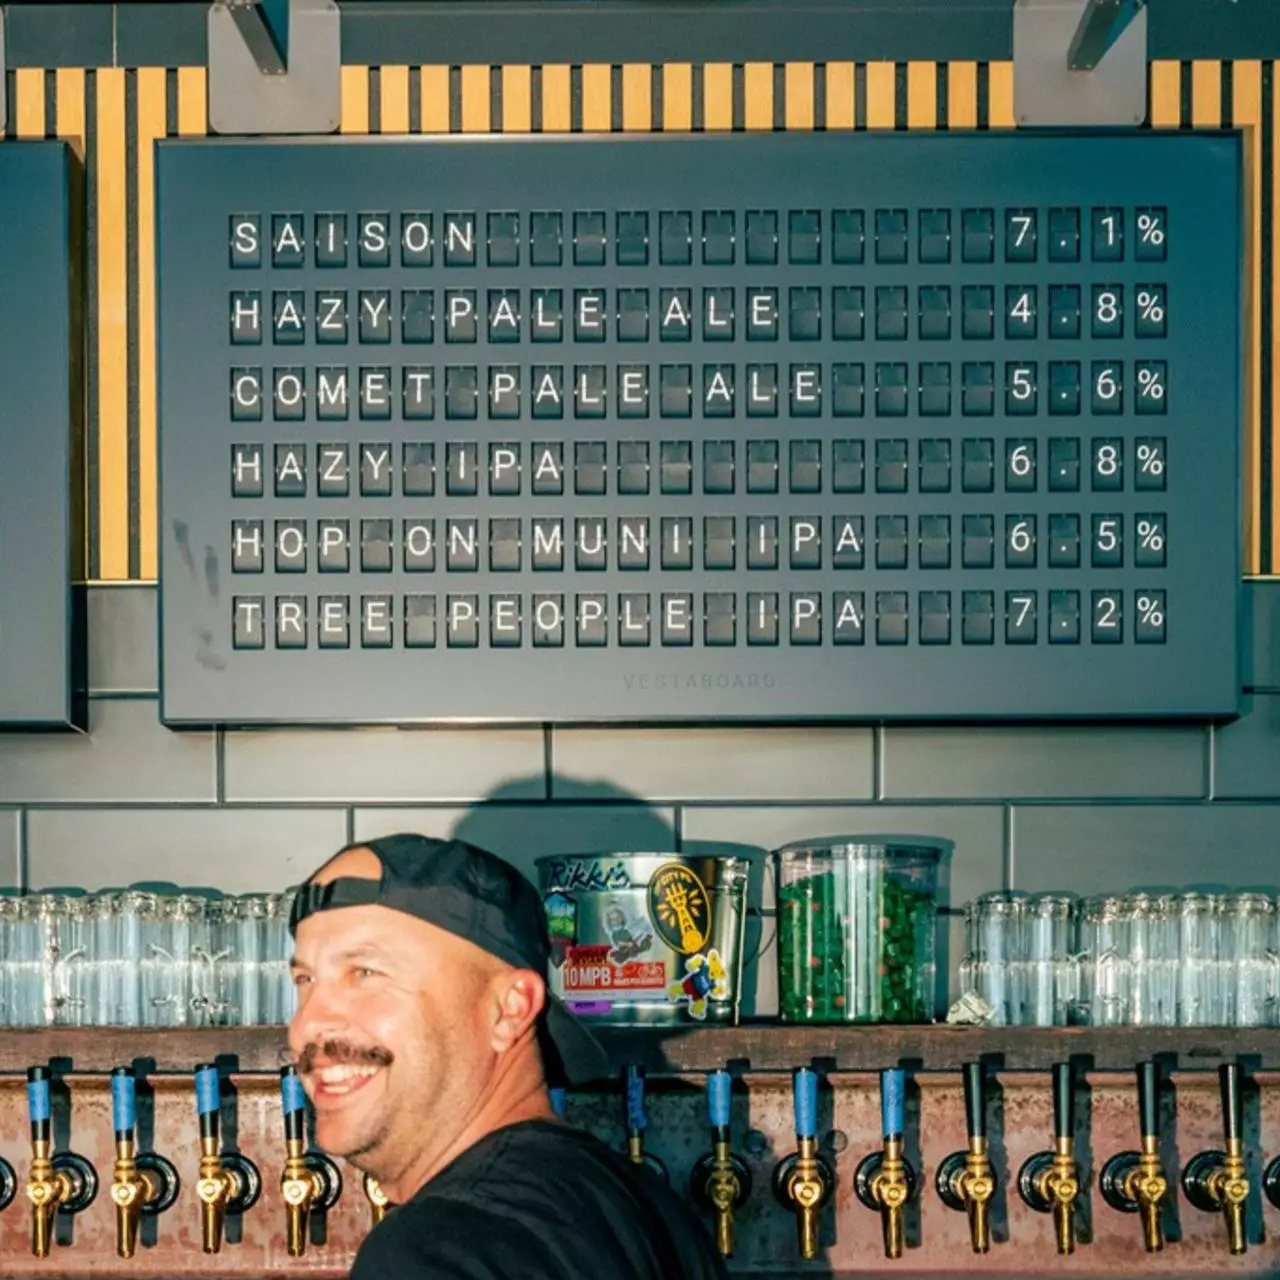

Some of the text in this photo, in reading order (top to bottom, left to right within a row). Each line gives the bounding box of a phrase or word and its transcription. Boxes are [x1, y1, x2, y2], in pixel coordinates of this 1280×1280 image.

[236, 214, 1164, 253] SAISON 7.1%
[235, 291, 1164, 329] HAZY PALE ALE 4.8%
[236, 369, 1164, 406] COMET PALE ALE 5.6%
[237, 445, 1163, 482] HAZY IPA 6.8%
[236, 521, 1163, 558] HOP ON MUNI IPA 6.5%
[238, 596, 1163, 633] TREE PEOPLE IPA 7.2%
